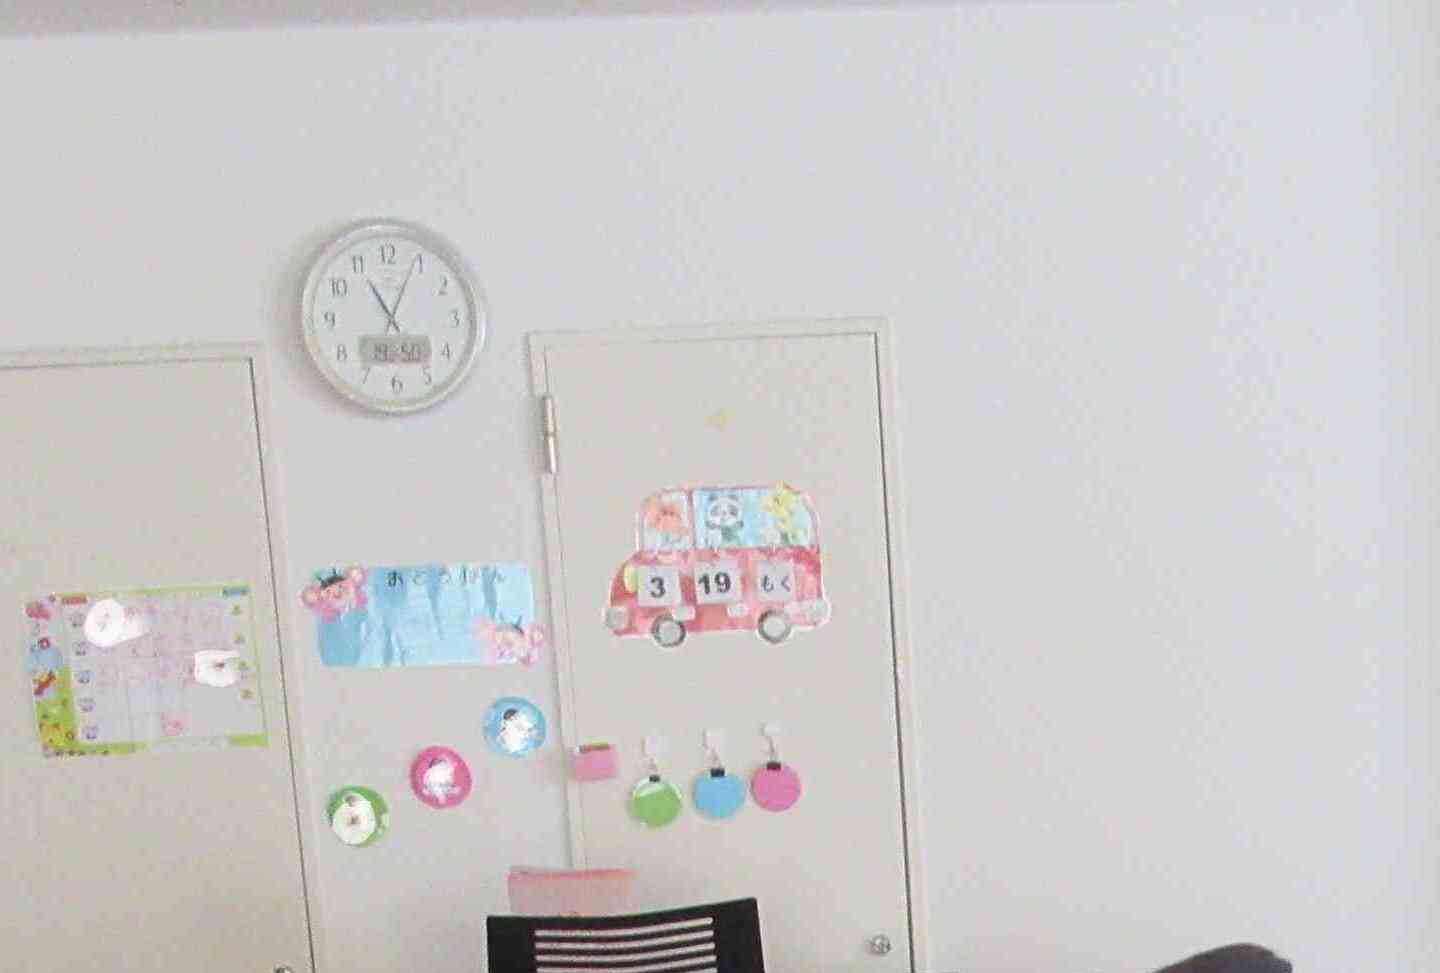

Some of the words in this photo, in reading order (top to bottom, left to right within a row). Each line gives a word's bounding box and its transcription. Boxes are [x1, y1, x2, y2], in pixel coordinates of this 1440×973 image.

[379, 244, 396, 265] 12
[416, 253, 424, 273] 1
[352, 255, 364, 273] 11
[331, 279, 348, 297] 10
[438, 275, 448, 295] 2
[324, 311, 336, 329] 9
[450, 310, 460, 328] 3
[336, 343, 348, 361] 8
[440, 342, 450, 361] 4
[361, 367, 371, 384] 7
[391, 375, 404, 393] 6
[423, 367, 433, 385] 5
[649, 577, 666, 598] 3
[698, 572, 732, 594] 19
